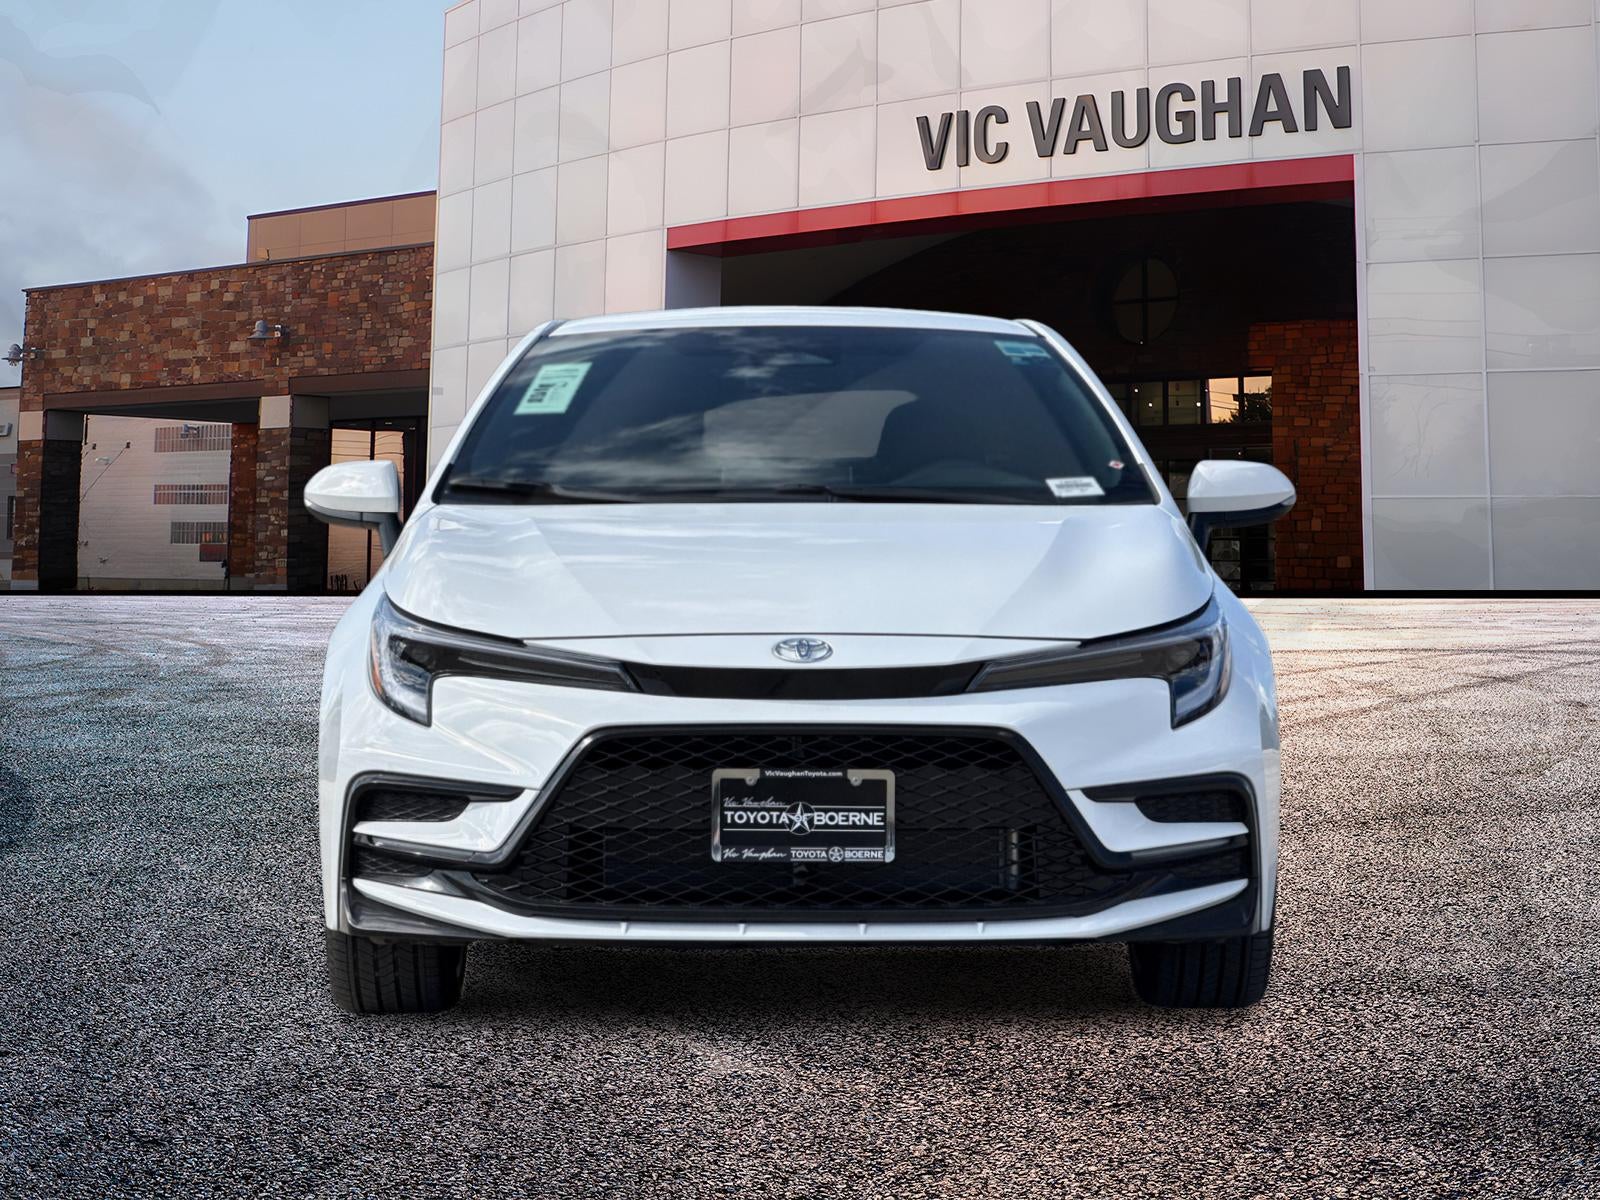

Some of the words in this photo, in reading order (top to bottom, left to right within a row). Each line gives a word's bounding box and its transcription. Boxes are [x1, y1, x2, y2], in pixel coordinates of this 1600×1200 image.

[916, 105, 1009, 170] VIC
[1026, 65, 1352, 158] VAUGHAN
[764, 769, 843, 778] VicVaughanToyota.com
[724, 811, 790, 824] TOYOTA
[813, 812, 884, 825] BOERNE
[790, 850, 828, 859] TOYOTA
[844, 850, 884, 859] BOERNE
